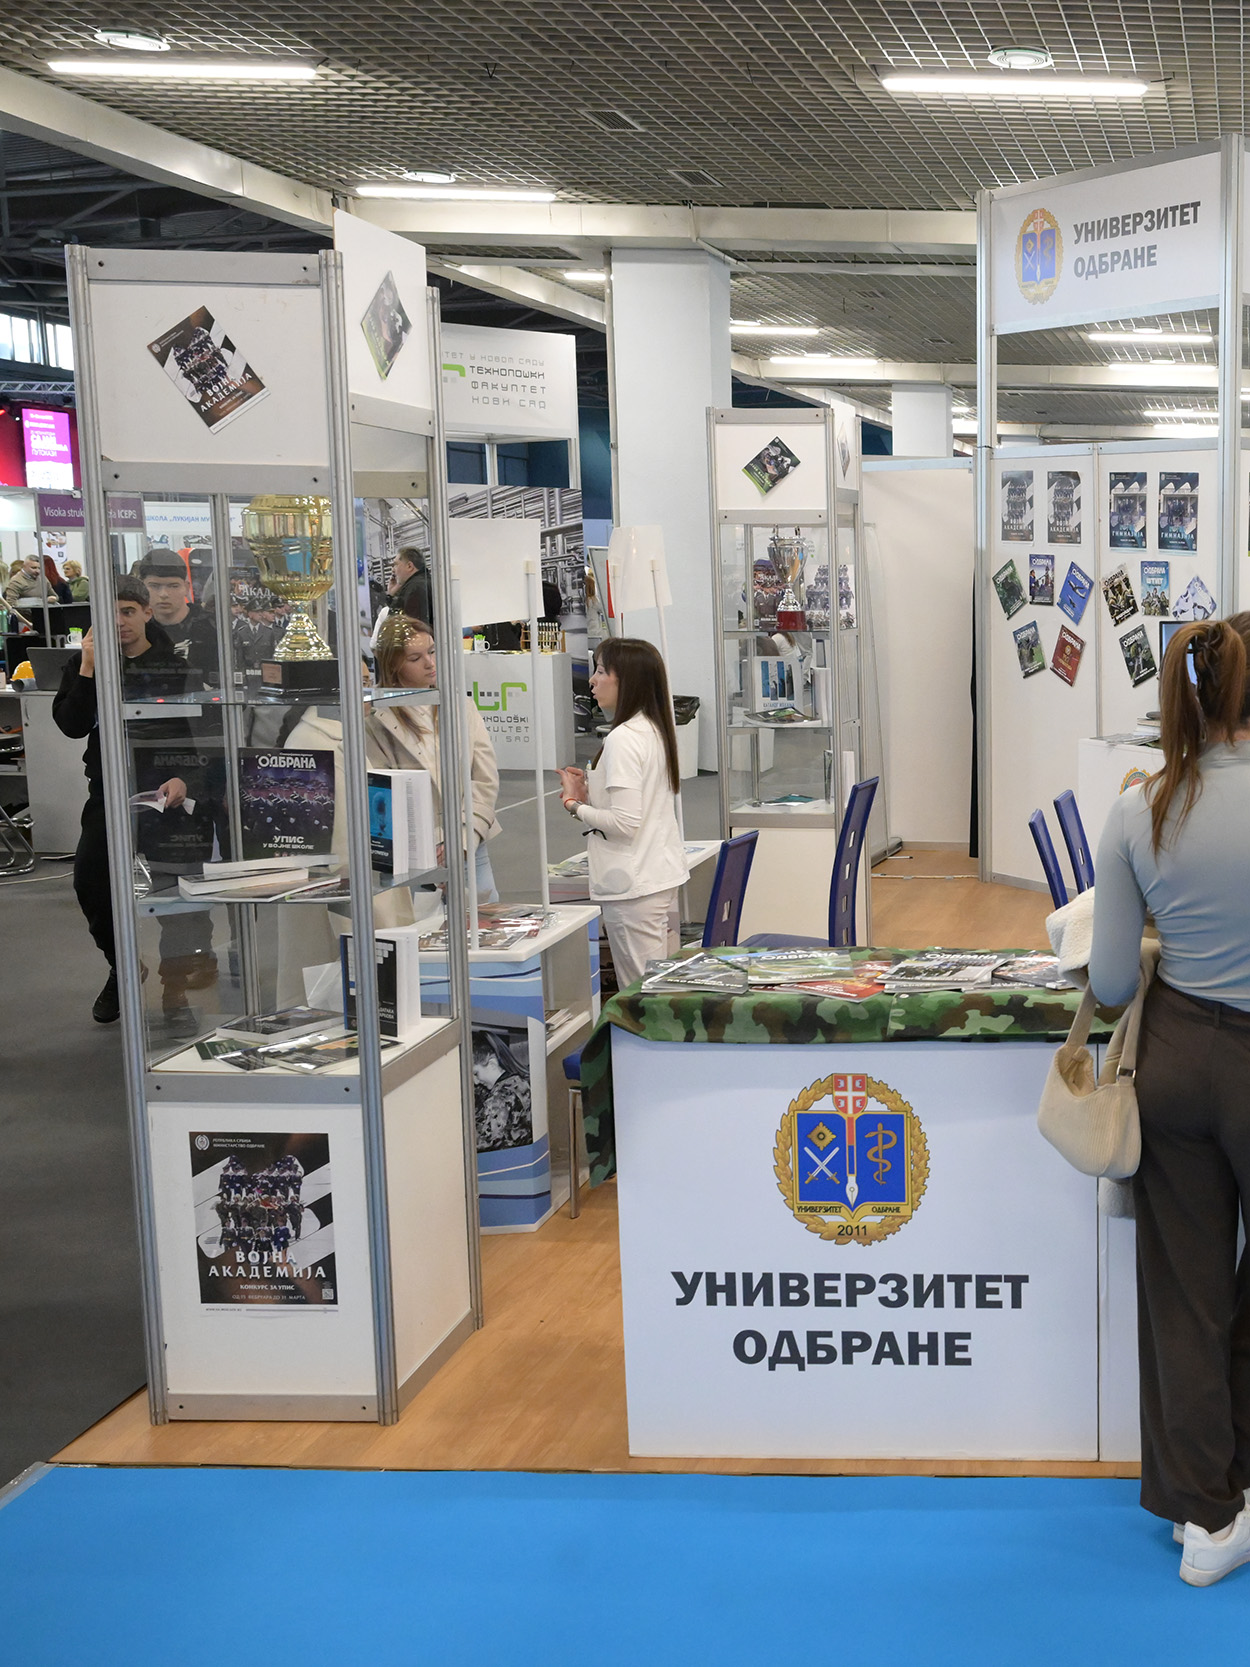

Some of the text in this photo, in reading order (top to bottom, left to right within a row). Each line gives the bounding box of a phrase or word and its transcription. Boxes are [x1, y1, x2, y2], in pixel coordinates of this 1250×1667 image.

[1073, 201, 1201, 244] УНИВЕРЗИТЕТ
[1073, 244, 1157, 280] ОДБРАНЕ
[471, 380, 546, 394] ФАКУЛТЕТ
[518, 398, 546, 410] САД
[44, 507, 66, 517] Visoka
[67, 507, 85, 518] struk
[117, 508, 137, 520] ICEPS
[257, 754, 317, 769] ОДБРАНА
[273, 835, 305, 845] УПИС
[796, 1205, 901, 1214] УНИВЕРЗИТЕТ ОДБРАНЕ
[837, 1224, 868, 1237] 2011
[235, 1250, 298, 1265] ВОЈНА
[208, 1265, 327, 1279] АКАДЕМИЈА
[670, 1271, 1030, 1309] УНИВЕРЗИТЕТ
[732, 1329, 972, 1372] ОДБРАНЕ
